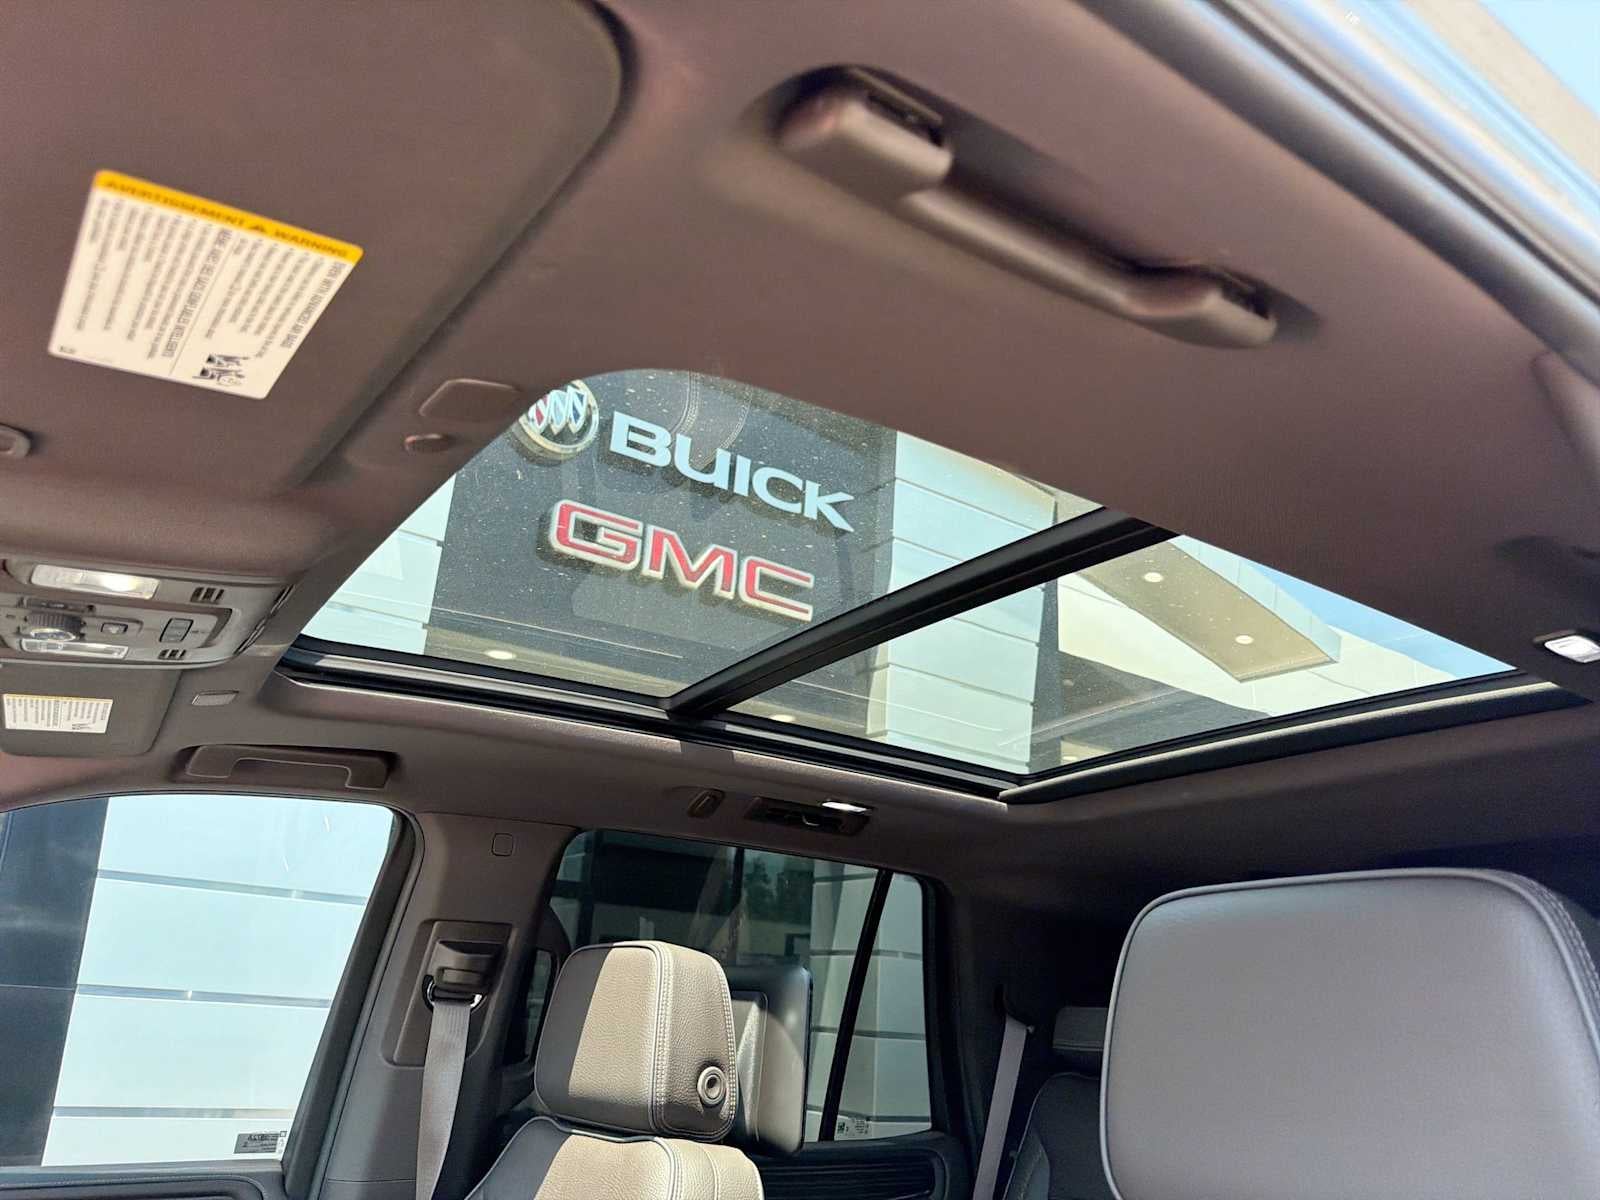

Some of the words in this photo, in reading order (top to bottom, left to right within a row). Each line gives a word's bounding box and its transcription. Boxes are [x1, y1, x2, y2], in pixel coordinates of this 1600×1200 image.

[274, 228, 347, 257] WARNING
[609, 410, 855, 532] BUICK
[548, 499, 815, 622] GMC
